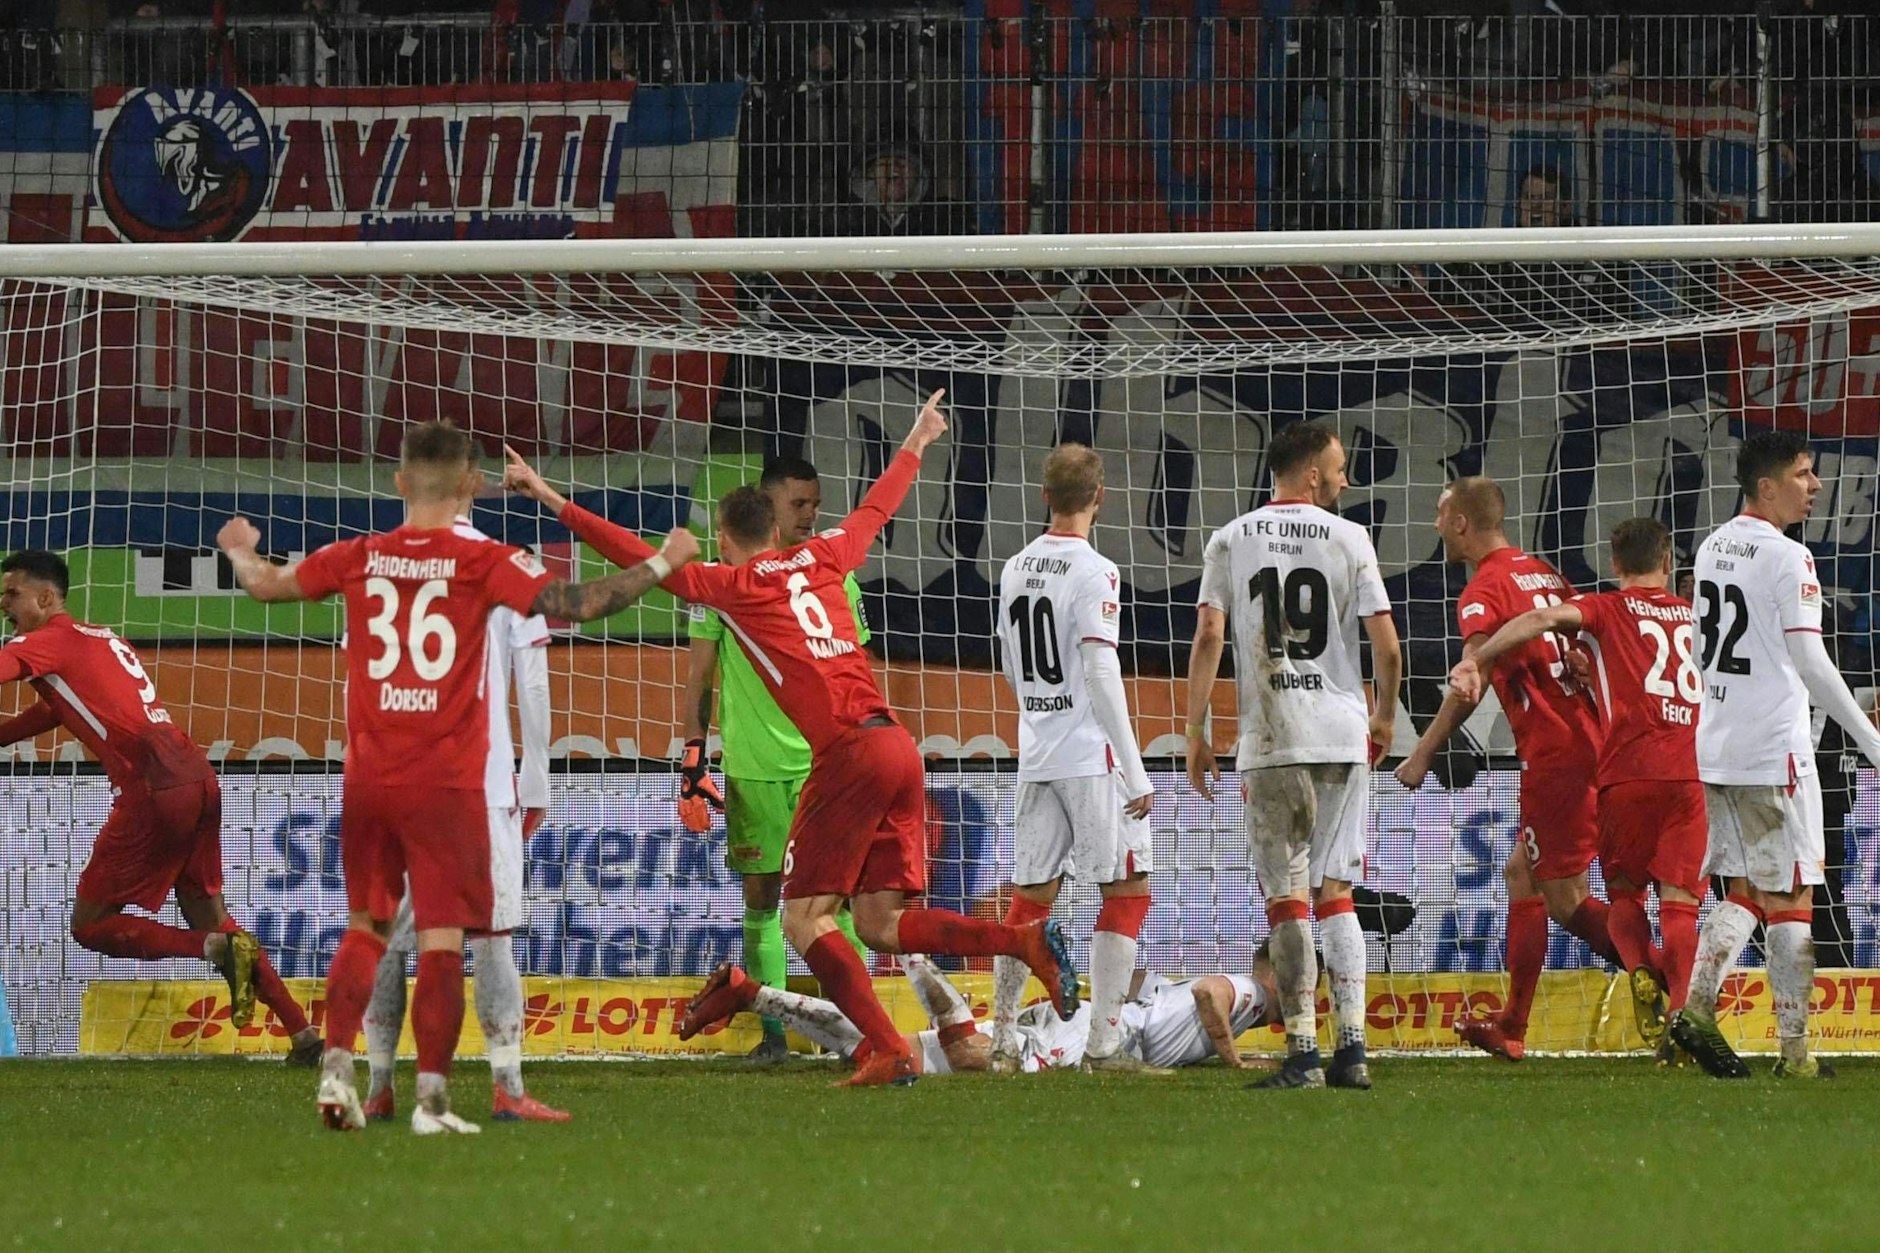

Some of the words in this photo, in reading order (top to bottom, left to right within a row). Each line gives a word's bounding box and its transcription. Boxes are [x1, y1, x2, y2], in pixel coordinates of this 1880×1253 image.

[145, 88, 260, 152] AVANTI
[270, 114, 613, 211] AVANTI
[1241, 523, 1252, 537] 1.
[1256, 520, 1274, 536] FC
[1279, 522, 1330, 541] UNION
[1268, 542, 1303, 556] BERLIN
[364, 550, 456, 579] HEIDENHEIM
[366, 577, 457, 682] 36
[786, 572, 834, 639] 6
[1248, 567, 1329, 660] 19
[1625, 597, 1695, 623] HEIDENHEI
[1699, 579, 1751, 676] 32
[108, 638, 156, 704] 9
[1009, 595, 1064, 685] 10
[1638, 619, 1704, 704] 28
[380, 682, 438, 712] DORSCH
[1023, 694, 1074, 713] DERSSON
[1662, 698, 1693, 726] FEICK
[783, 840, 796, 876] 6
